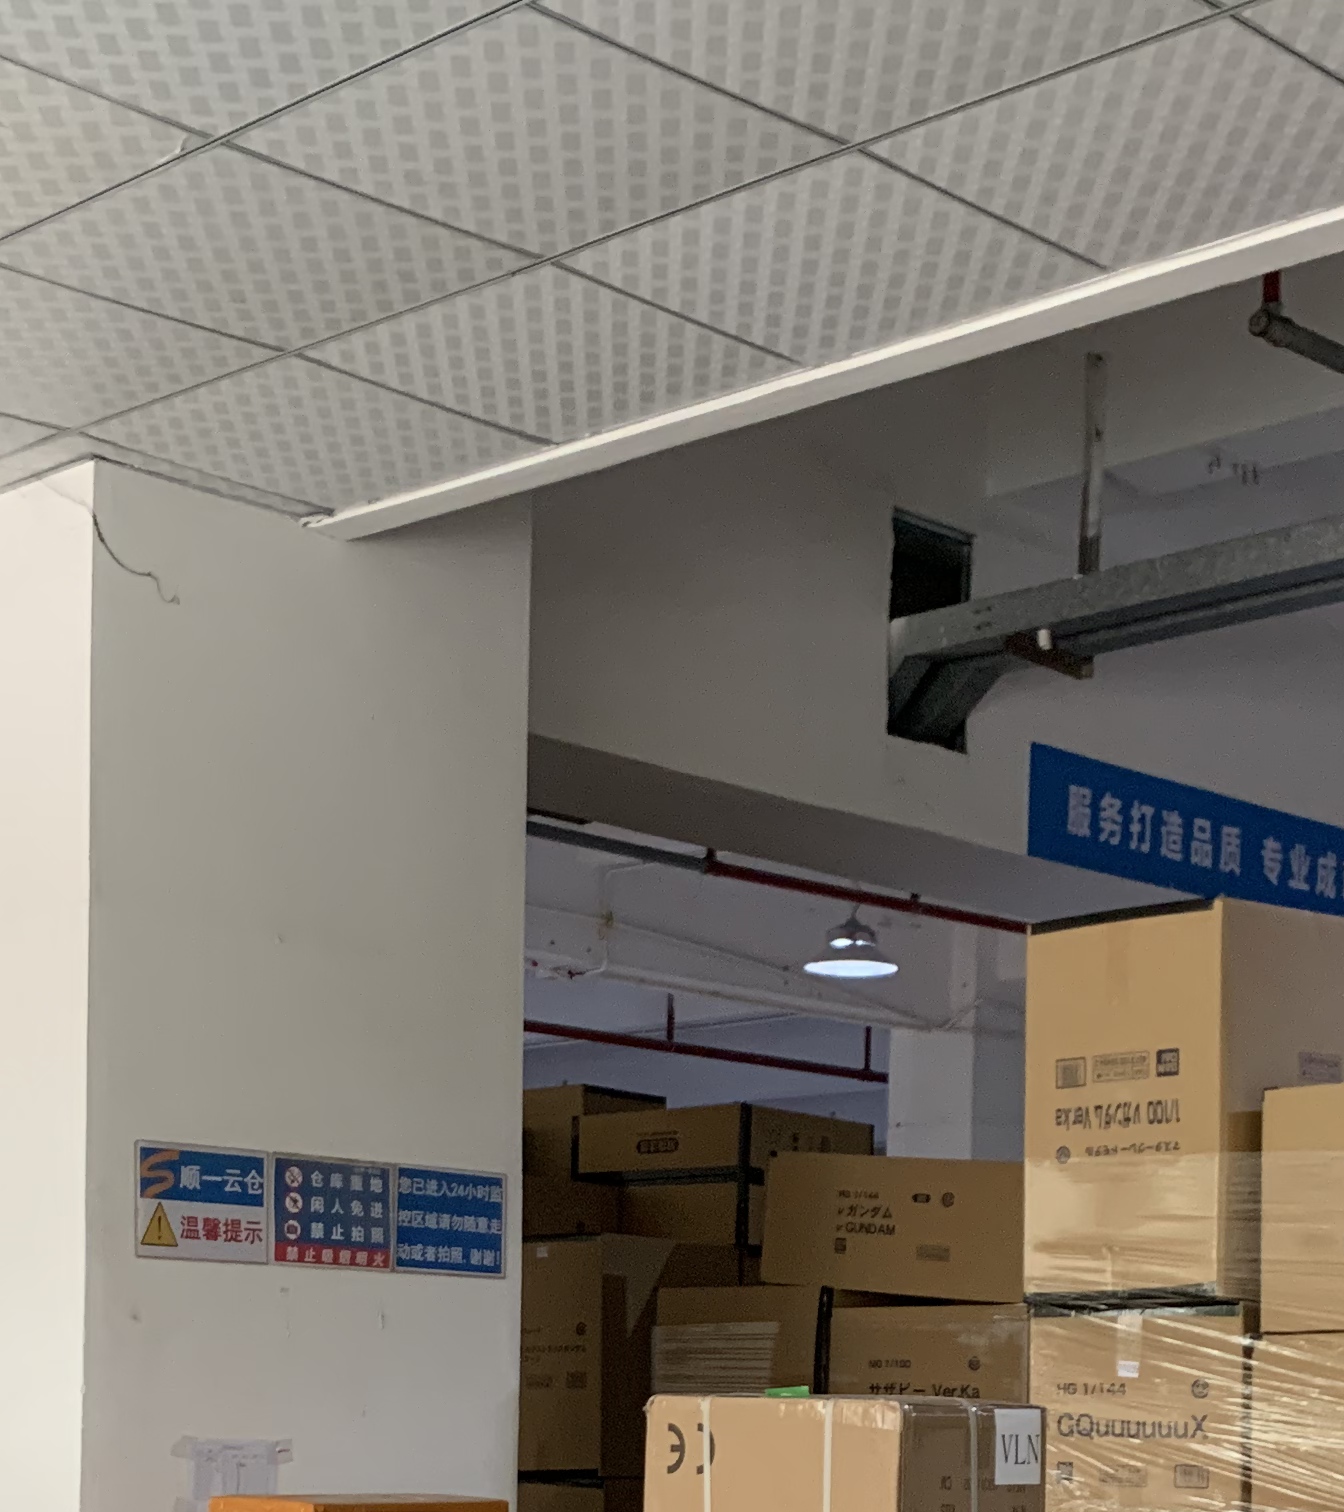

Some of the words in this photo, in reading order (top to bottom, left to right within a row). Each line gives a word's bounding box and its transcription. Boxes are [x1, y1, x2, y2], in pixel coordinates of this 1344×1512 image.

[1067, 784, 1242, 876] 服务打造品质
[180, 1165, 264, 1195] 顺一云仓
[310, 1170, 384, 1193] 仓库重地
[397, 1175, 503, 1202] 您已进入24小时监
[310, 1197, 384, 1219] 闲人免进
[180, 1215, 264, 1245] 温馨提示
[309, 1225, 385, 1244] 禁止拍照
[397, 1210, 503, 1236] 控区域请勿随意走
[1082, 1382, 1127, 1396] 1/144
[1001, 1433, 1041, 1467] VLN
